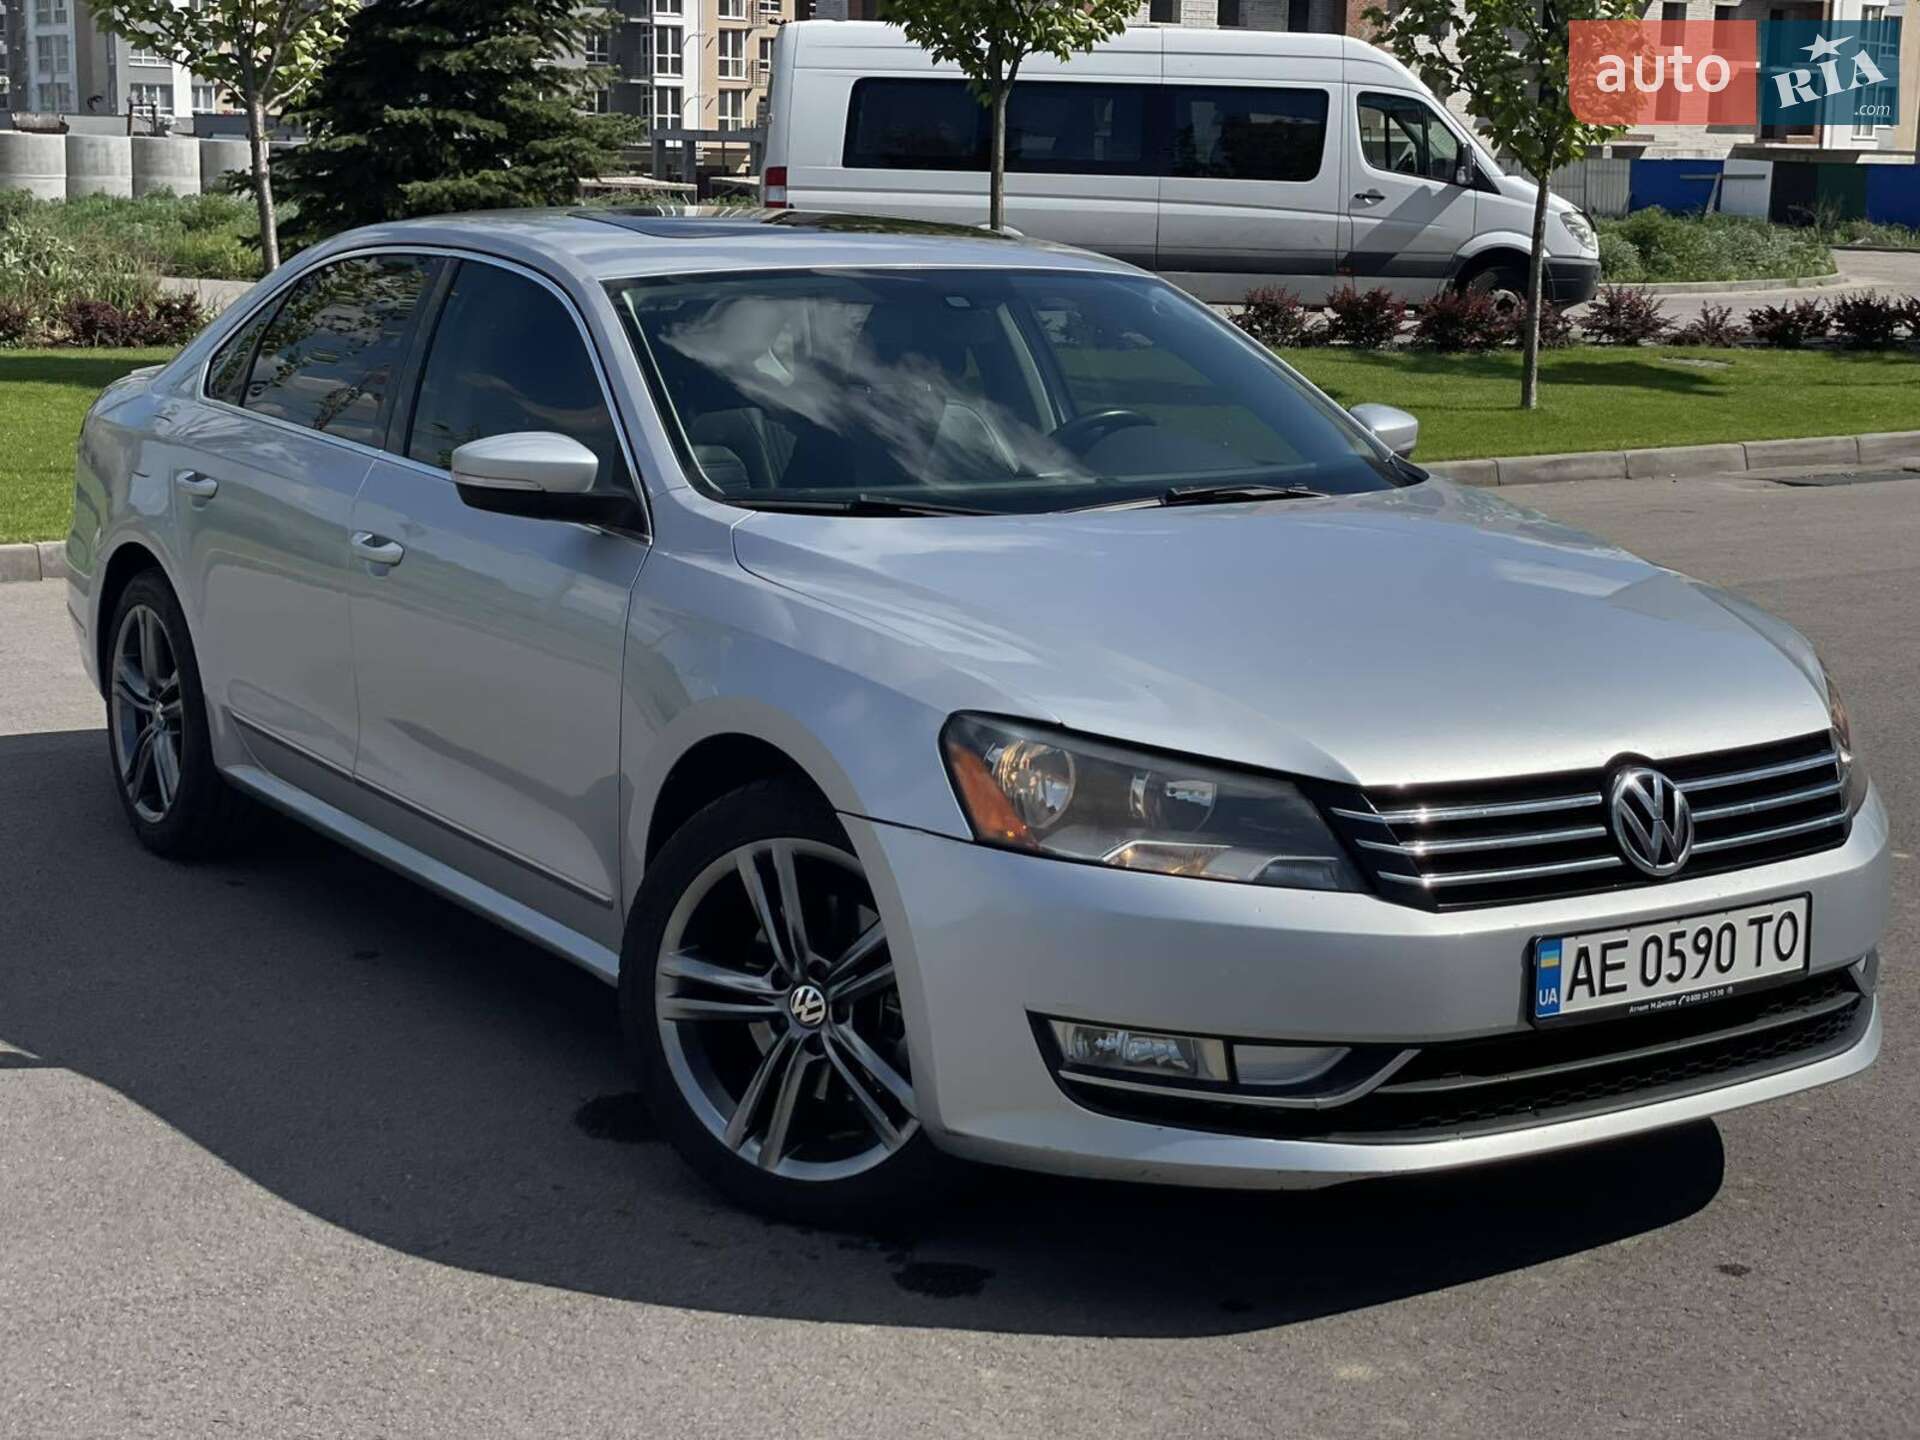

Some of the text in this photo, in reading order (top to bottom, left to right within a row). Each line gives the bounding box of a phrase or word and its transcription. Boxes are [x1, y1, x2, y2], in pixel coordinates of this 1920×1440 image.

[1566, 939, 1629, 1002] AE
[1640, 922, 1737, 987] 0590
[1747, 911, 1799, 968] TO
[1539, 987, 1558, 1006] UA
